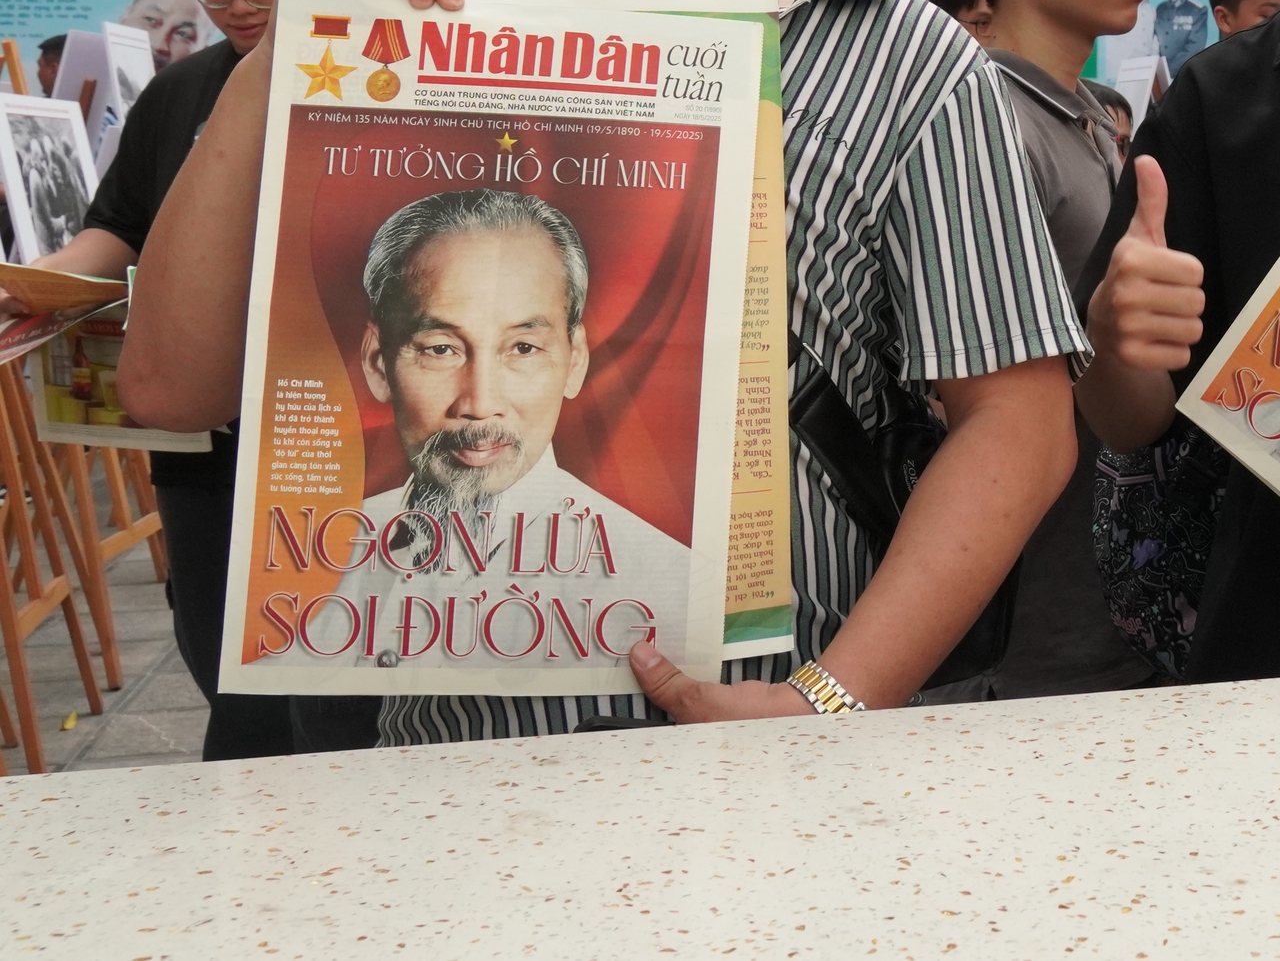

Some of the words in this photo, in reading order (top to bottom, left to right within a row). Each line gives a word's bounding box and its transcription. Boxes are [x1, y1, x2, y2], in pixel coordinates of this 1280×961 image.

[417, 20, 555, 77] Nhân
[560, 34, 662, 85] Dân
[666, 39, 728, 70] cuối
[661, 70, 724, 103] tuần
[635, 110, 655, 118] NAM
[308, 112, 322, 122] KỶ
[324, 112, 352, 123] NIỆM
[355, 114, 371, 124] 135
[373, 115, 399, 125] NĂM
[401, 116, 431, 126] NGÀY
[433, 117, 458, 128] SINH
[460, 118, 484, 129] CHỦ
[486, 119, 511, 130] TỊCH
[513, 120, 532, 131] HỒ
[533, 122, 552, 132] CHÍ
[554, 123, 584, 133] MINH
[586, 124, 641, 137] (19/5/1890
[650, 128, 704, 141] 19/5/2025)
[324, 145, 360, 176] TƯ
[369, 143, 485, 183] TƯỞNG
[496, 147, 542, 184] HỒ
[553, 152, 609, 187] CHÍ
[617, 159, 686, 191] MINH
[304, 379, 324, 389] Minh
[274, 413, 287, 422] khi
[282, 437, 295, 446] khi
[271, 460, 288, 471] gian
[324, 462, 341, 471] vinh
[266, 506, 492, 580] NGỌN
[511, 497, 618, 577] LỬA
[742, 561, 757, 570] cho
[747, 580, 765, 588] ham
[258, 593, 376, 658] SOI
[395, 584, 656, 661] ĐƯỜNG
